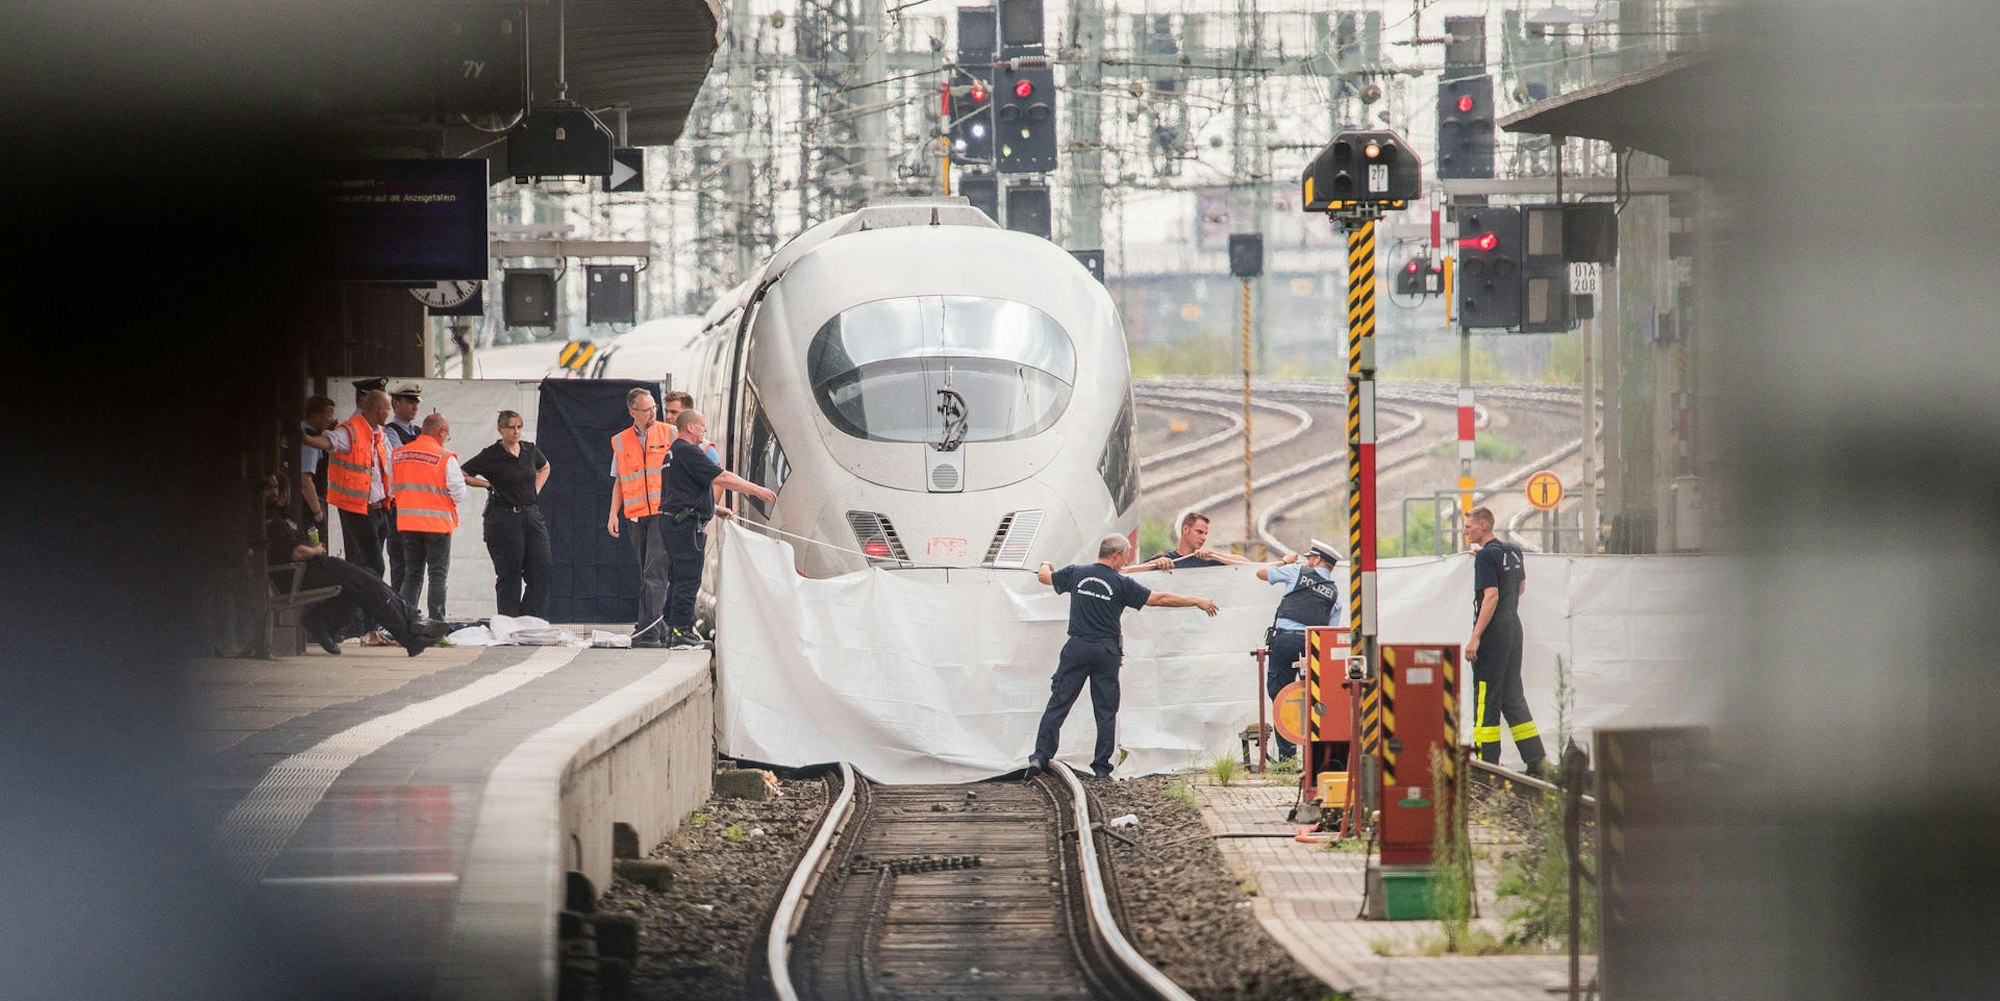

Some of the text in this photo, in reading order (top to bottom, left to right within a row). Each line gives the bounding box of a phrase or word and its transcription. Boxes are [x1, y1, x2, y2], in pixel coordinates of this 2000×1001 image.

[1575, 264, 1596, 278] 01A
[1574, 279, 1596, 291] 208
[1299, 575, 1334, 599] POLIZEI
